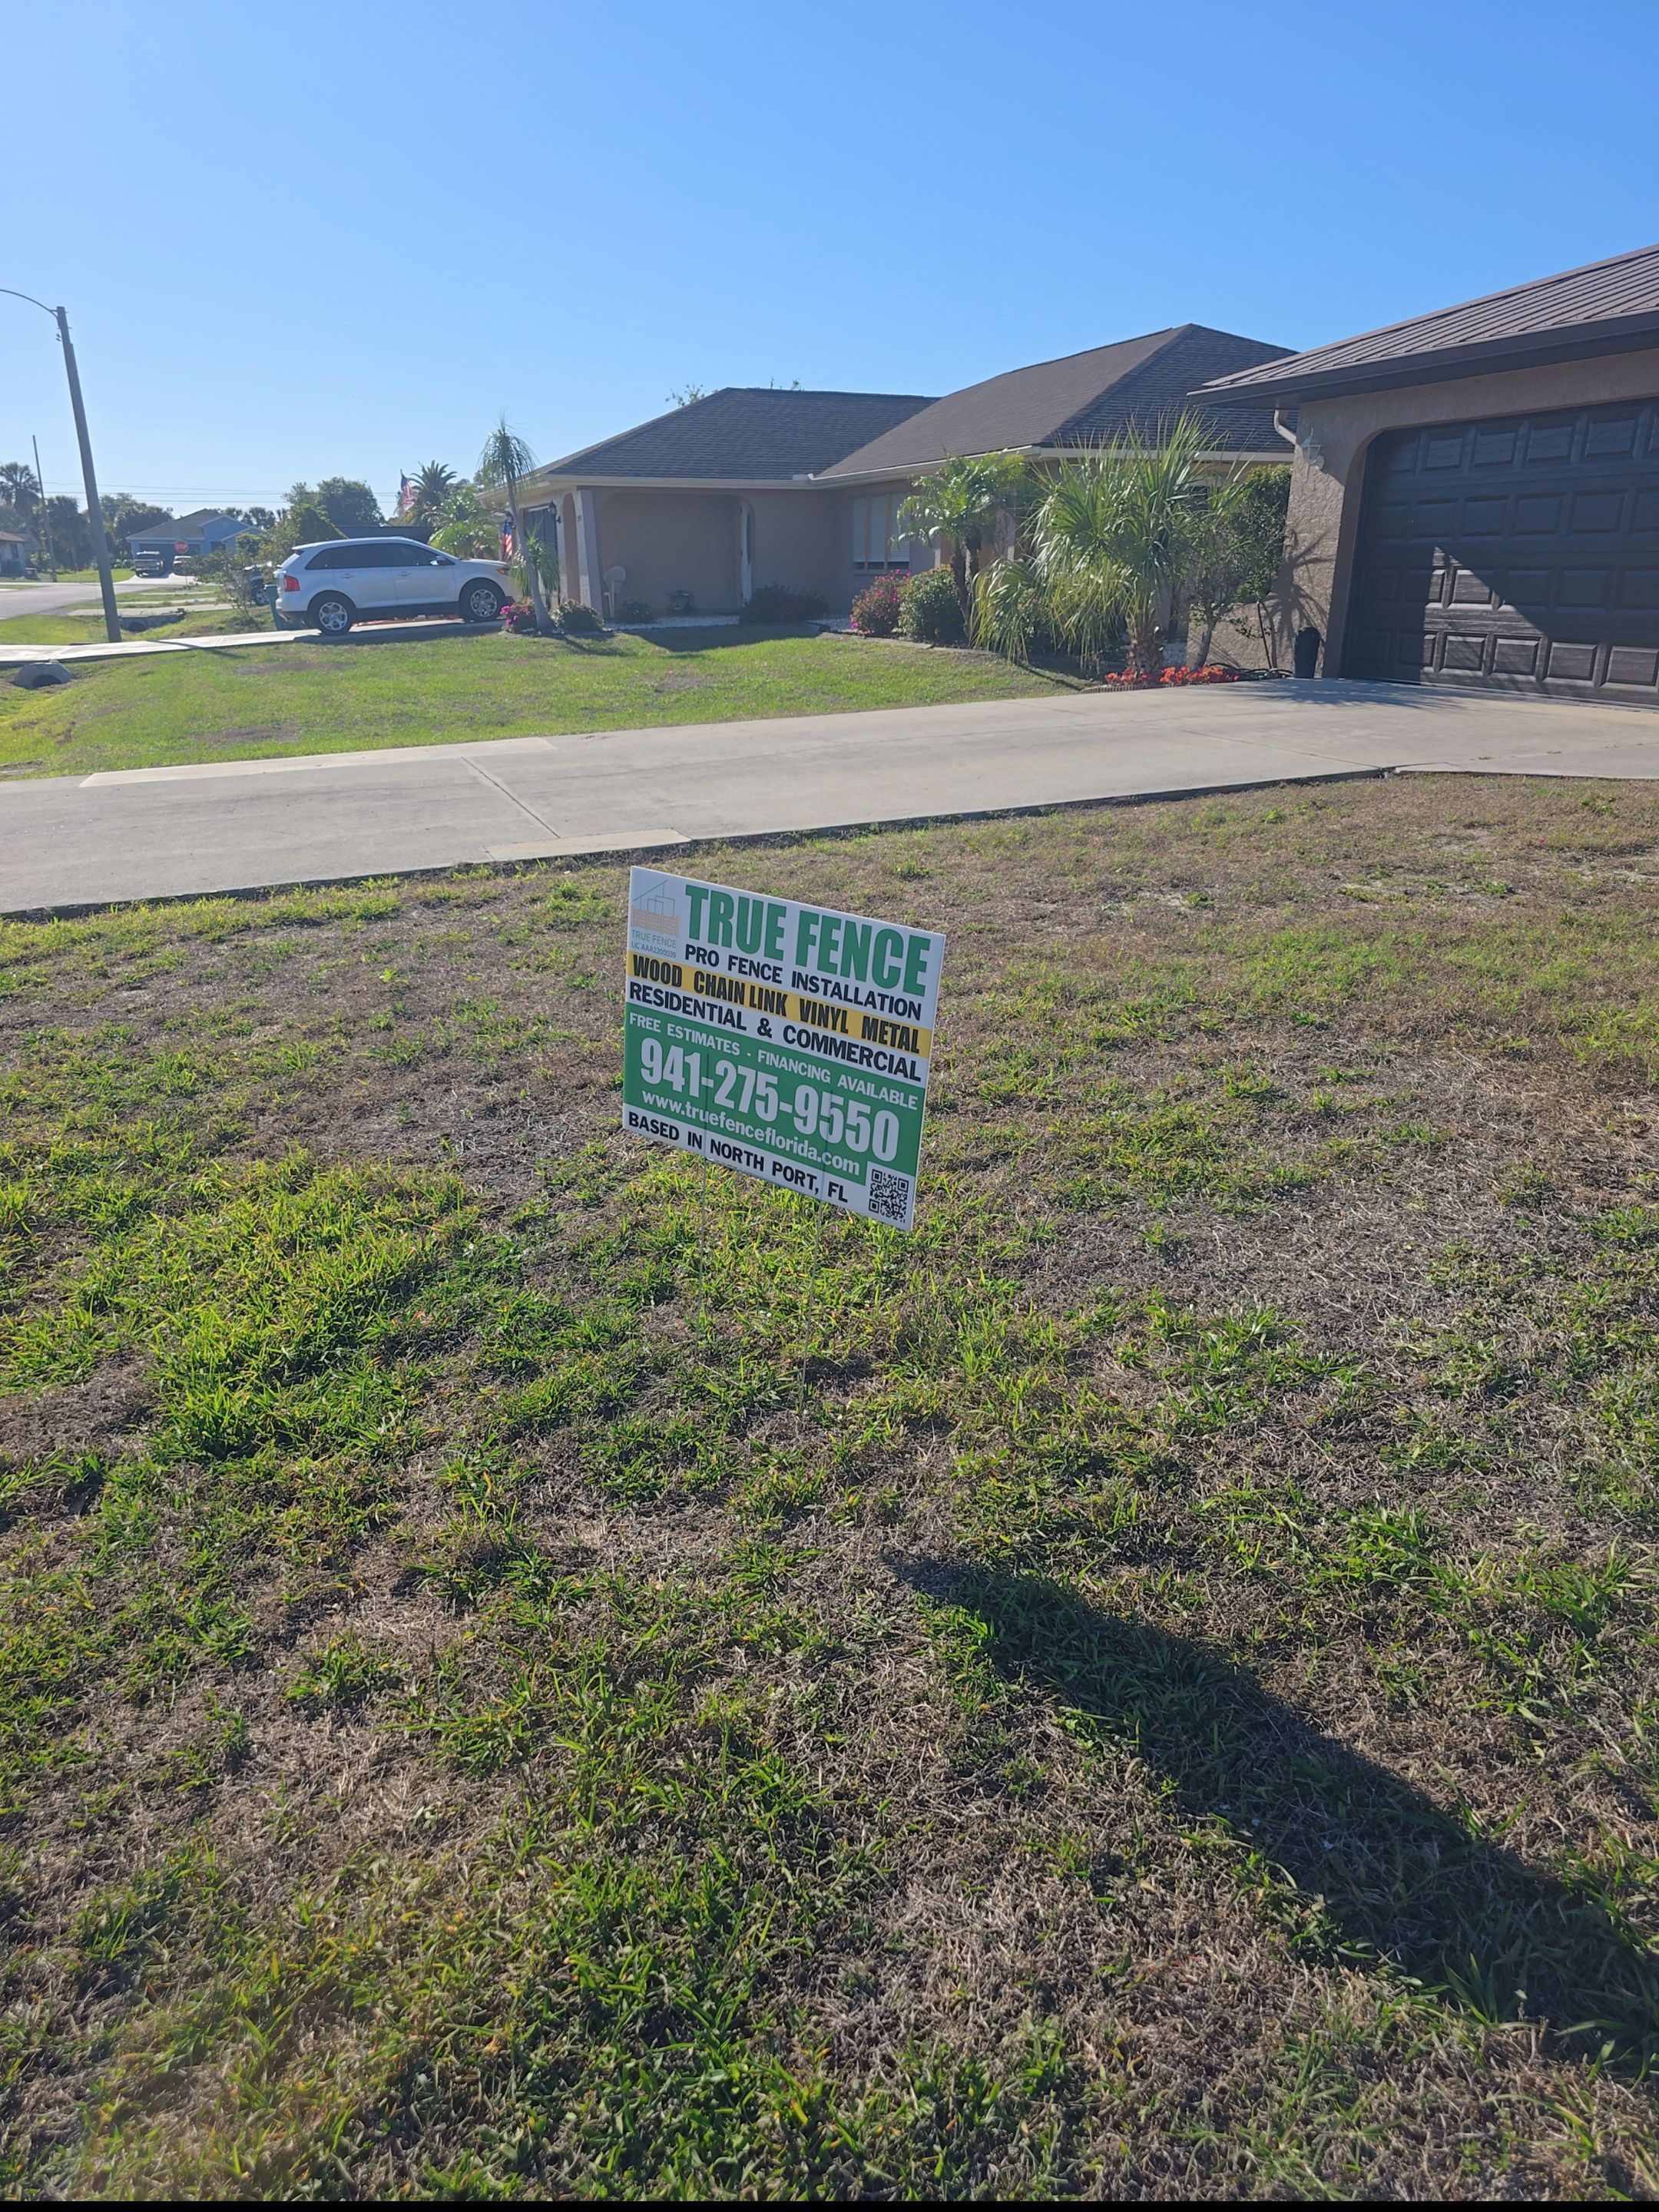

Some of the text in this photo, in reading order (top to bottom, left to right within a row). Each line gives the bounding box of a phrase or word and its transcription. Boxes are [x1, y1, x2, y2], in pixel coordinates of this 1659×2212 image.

[631, 929, 677, 949] TRUE FENCE
[685, 884, 931, 996] TRUE FENCE
[685, 944, 922, 1021] PRO FENCE INSTALLATION
[630, 982, 922, 1082] RESIDENTIAL & COMMERCIAL
[633, 954, 920, 1054] WOOD CHAIN LINK VINYL METAL
[629, 1012, 662, 1033] FREE
[667, 1022, 740, 1057] ESTIMATES
[757, 1049, 831, 1084] FINANCING
[837, 1075, 919, 1111] AVAILABLE
[641, 1037, 899, 1162] 941-275-9550
[628, 1111, 849, 1204] BASED IN NORTH PORT, FL
[642, 1091, 860, 1176] www.truefenceflorida.com
